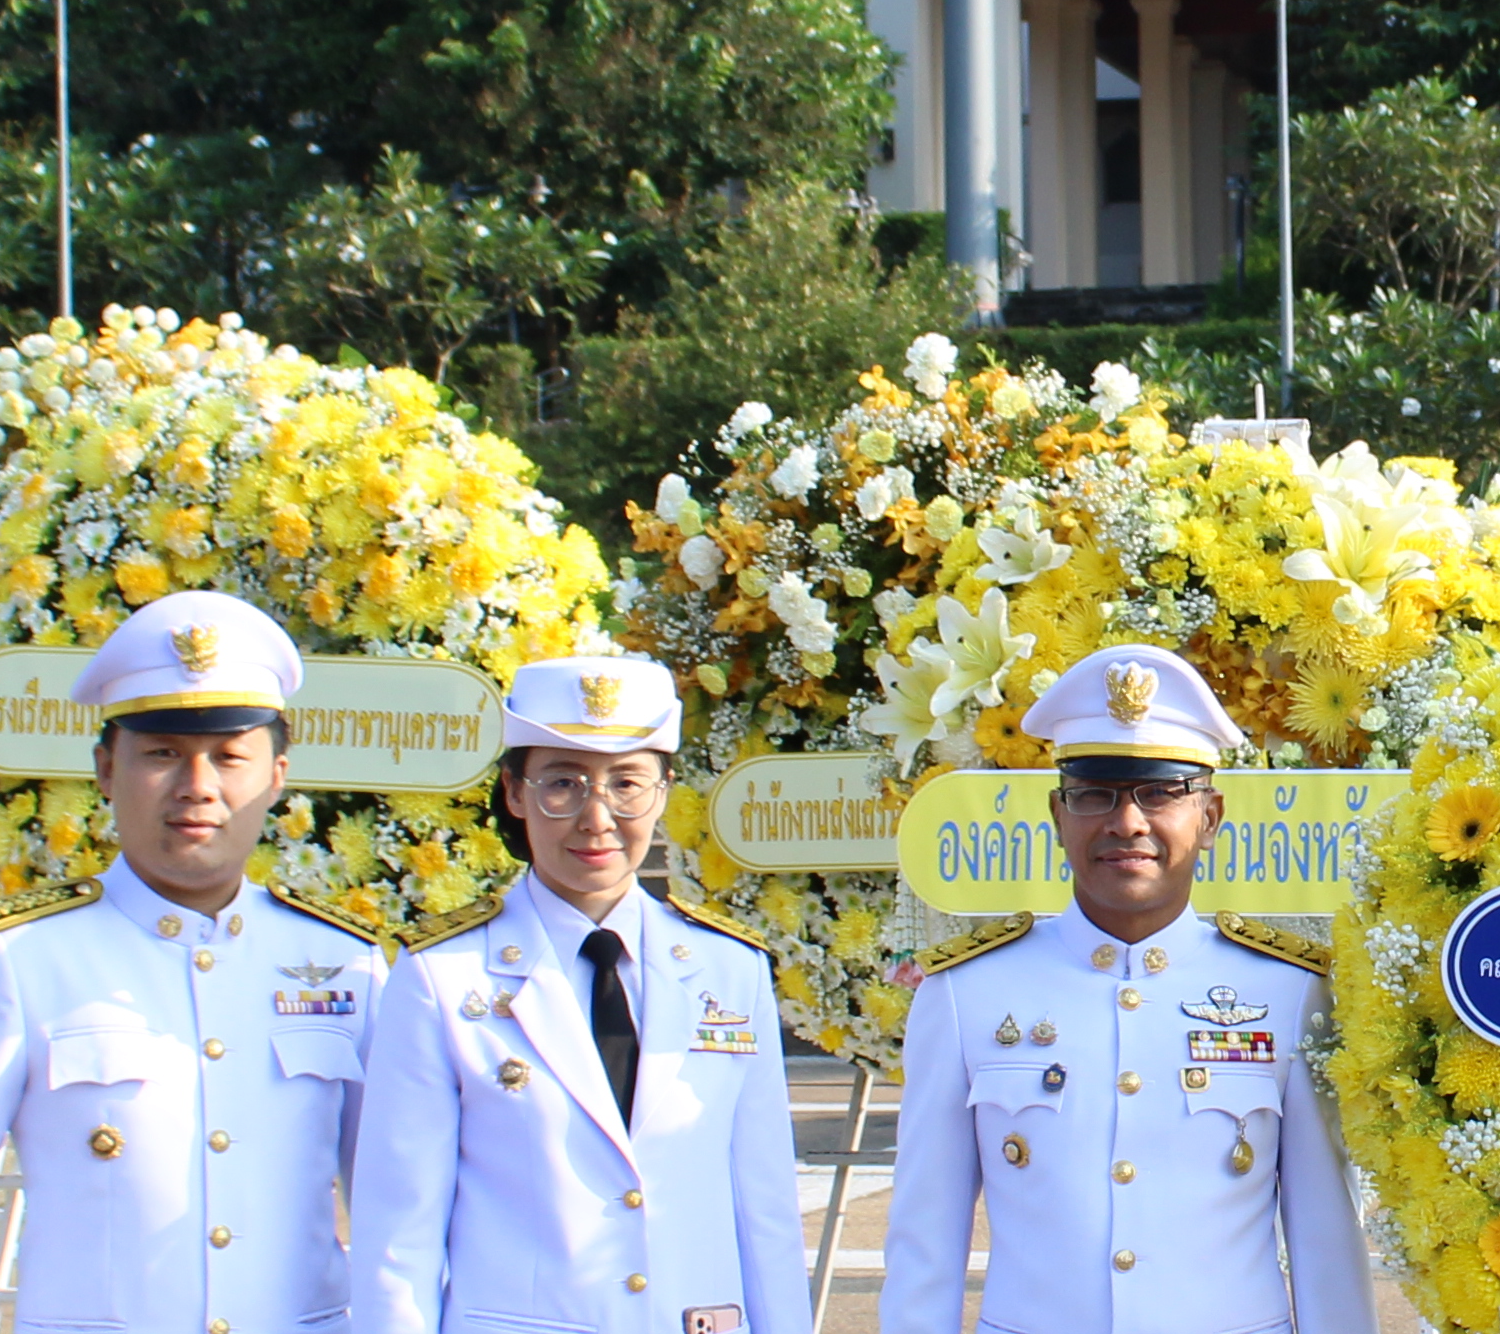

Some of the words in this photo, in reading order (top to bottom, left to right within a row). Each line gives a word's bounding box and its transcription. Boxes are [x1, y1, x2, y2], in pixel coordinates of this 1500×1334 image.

[740, 777, 900, 841] สำนักงานส่งเสร
